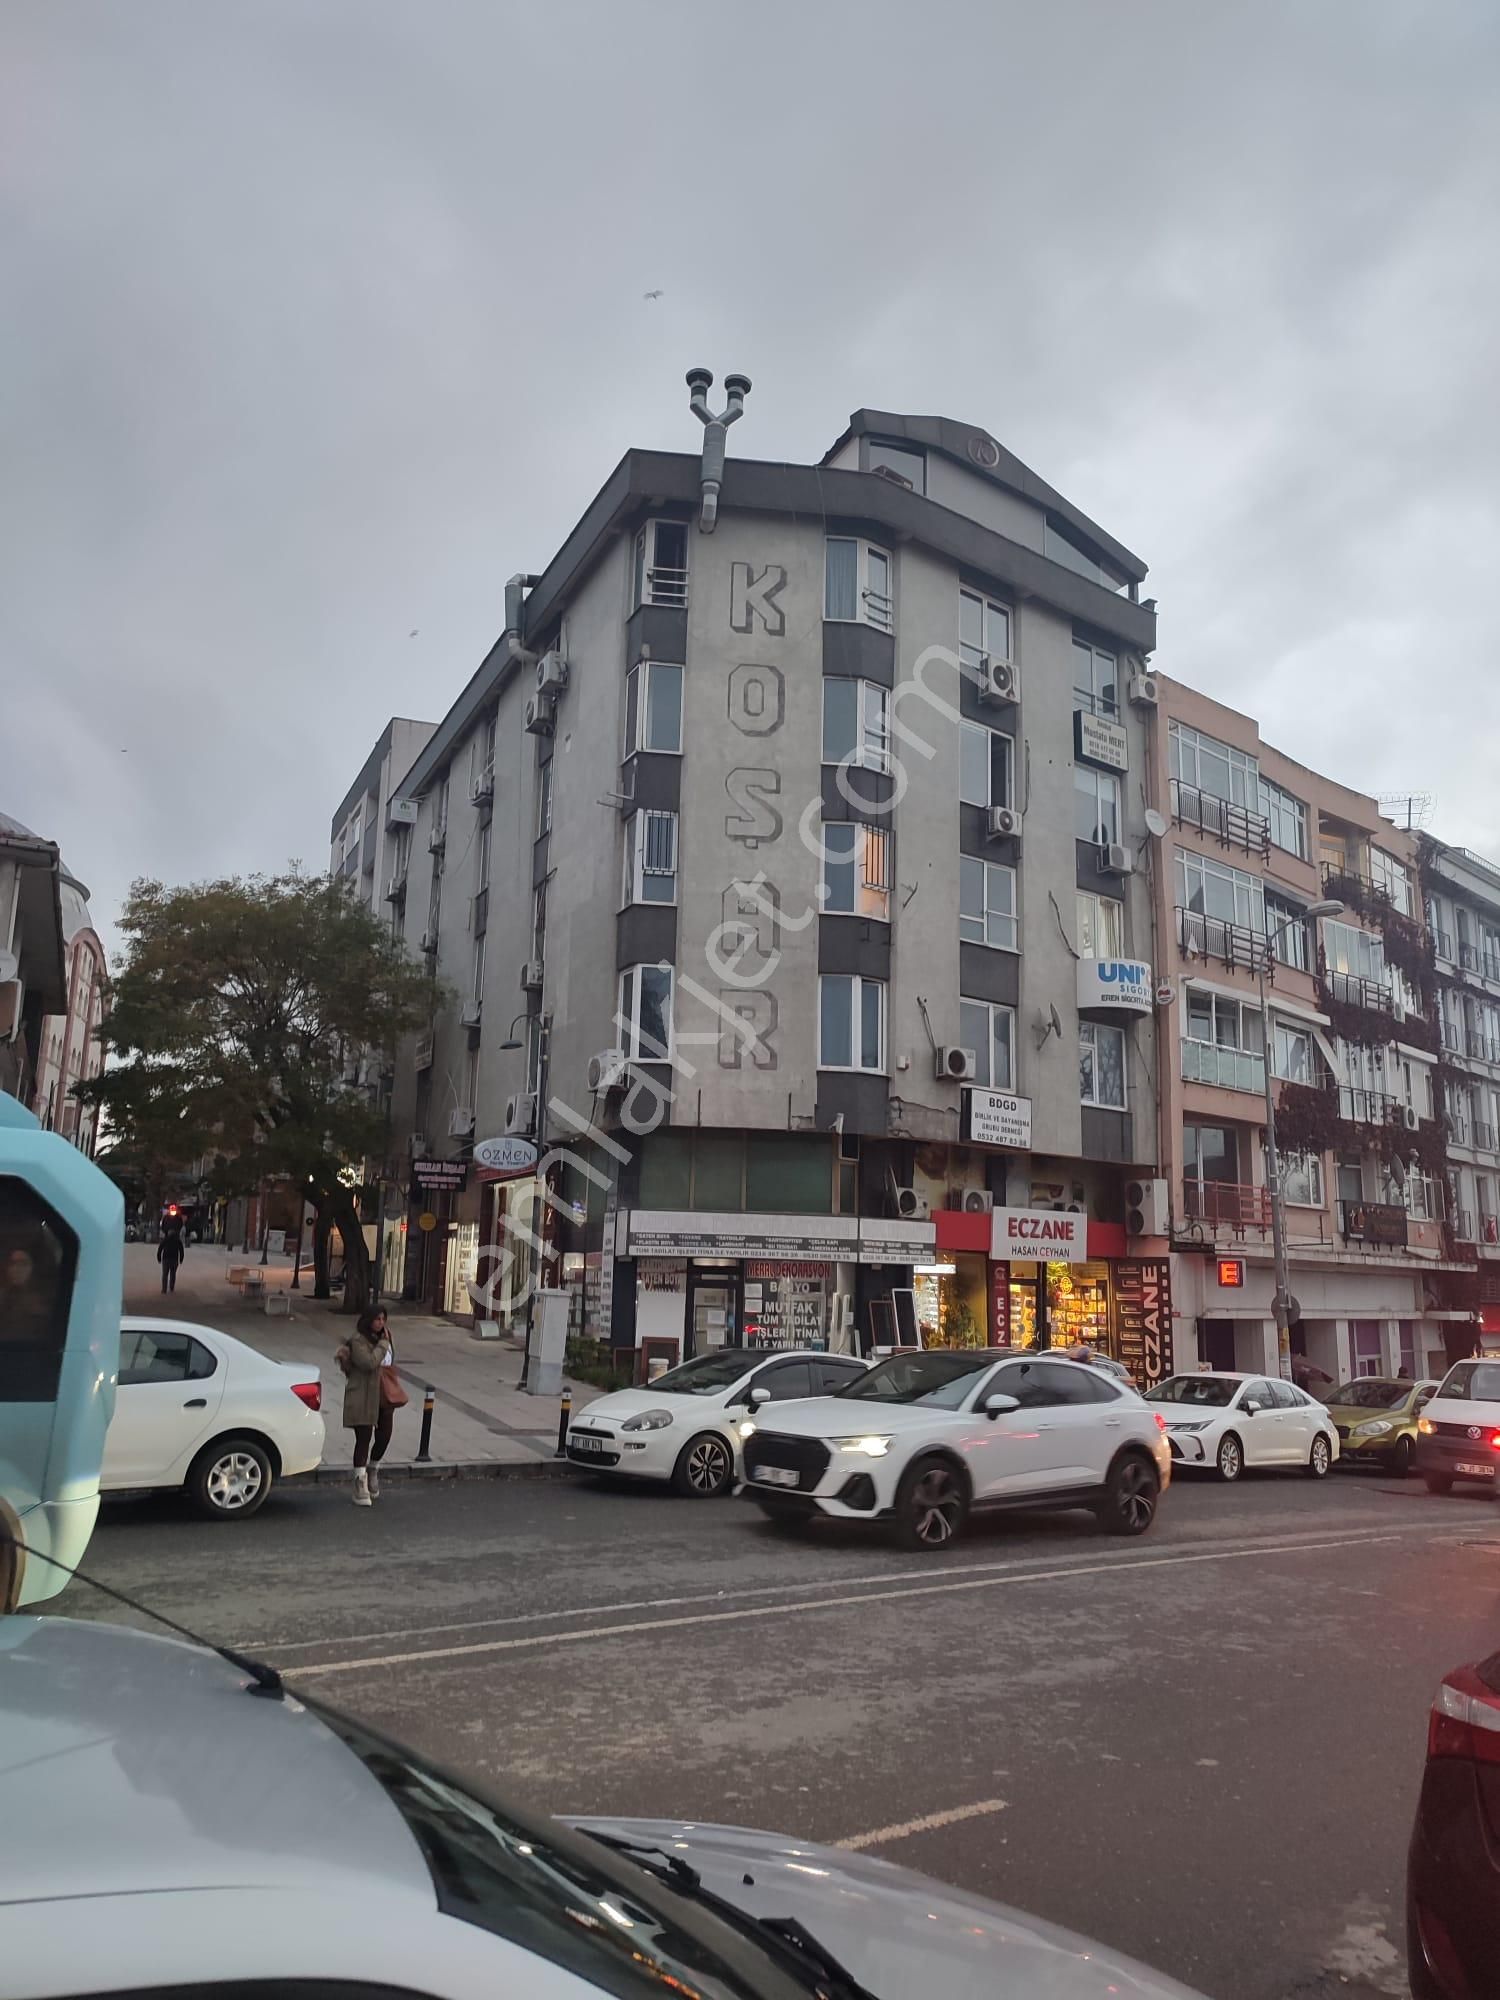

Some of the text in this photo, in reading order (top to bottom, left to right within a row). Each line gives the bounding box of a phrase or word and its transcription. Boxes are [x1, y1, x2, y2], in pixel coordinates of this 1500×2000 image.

[1109, 736, 1125, 750] MERT
[989, 1097, 1017, 1111] BDGD
[1008, 1217, 1074, 1240] ECZANE
[1011, 1246, 1070, 1258] HASAN CEYHAN
[1221, 1262, 1238, 1285] E
[765, 1301, 814, 1314] MUTFAK
[756, 1313, 779, 1325] TÜM
